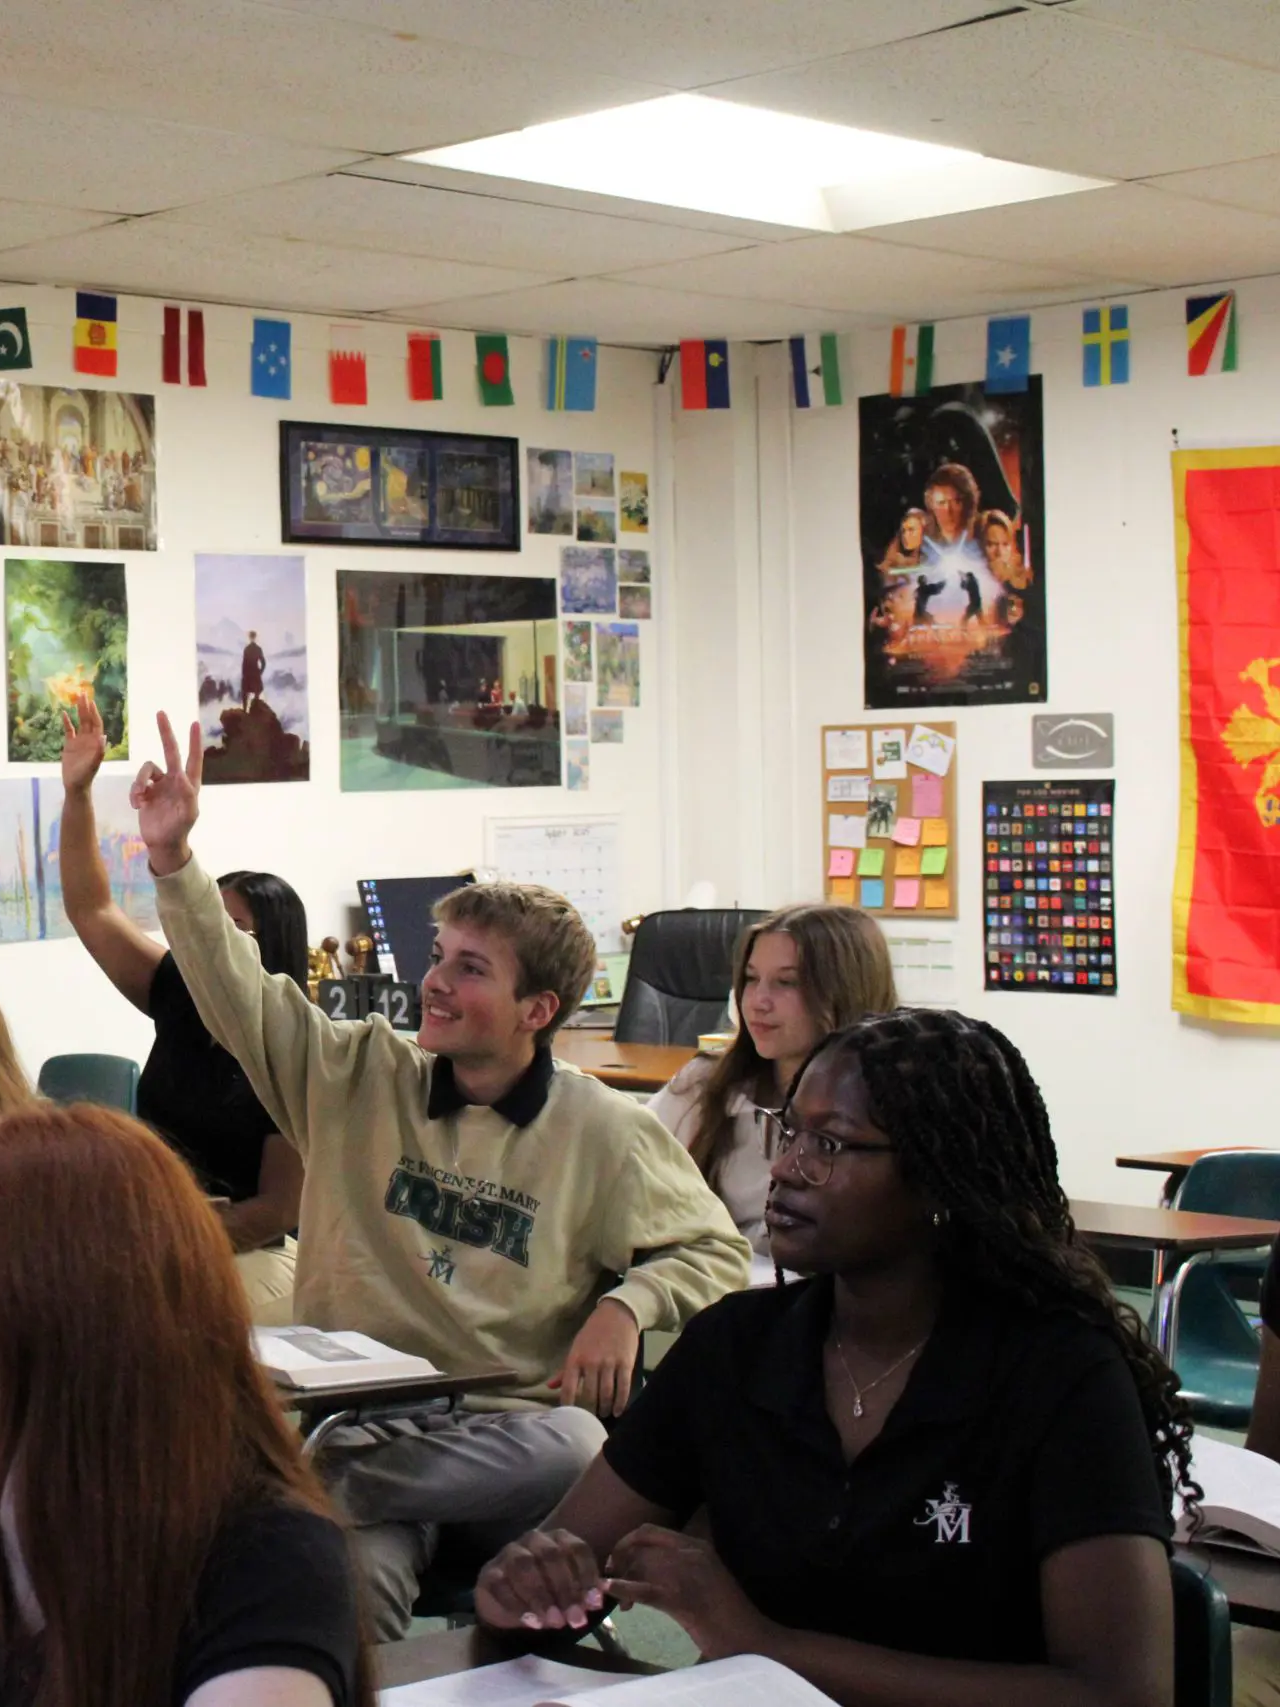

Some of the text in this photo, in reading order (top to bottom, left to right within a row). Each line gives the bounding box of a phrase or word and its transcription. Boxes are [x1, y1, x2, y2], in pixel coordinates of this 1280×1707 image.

[329, 985, 409, 1024] 2 12
[397, 1156, 415, 1173] ST.
[499, 1186, 541, 1214] MARY
[384, 1168, 535, 1268] IRISH
